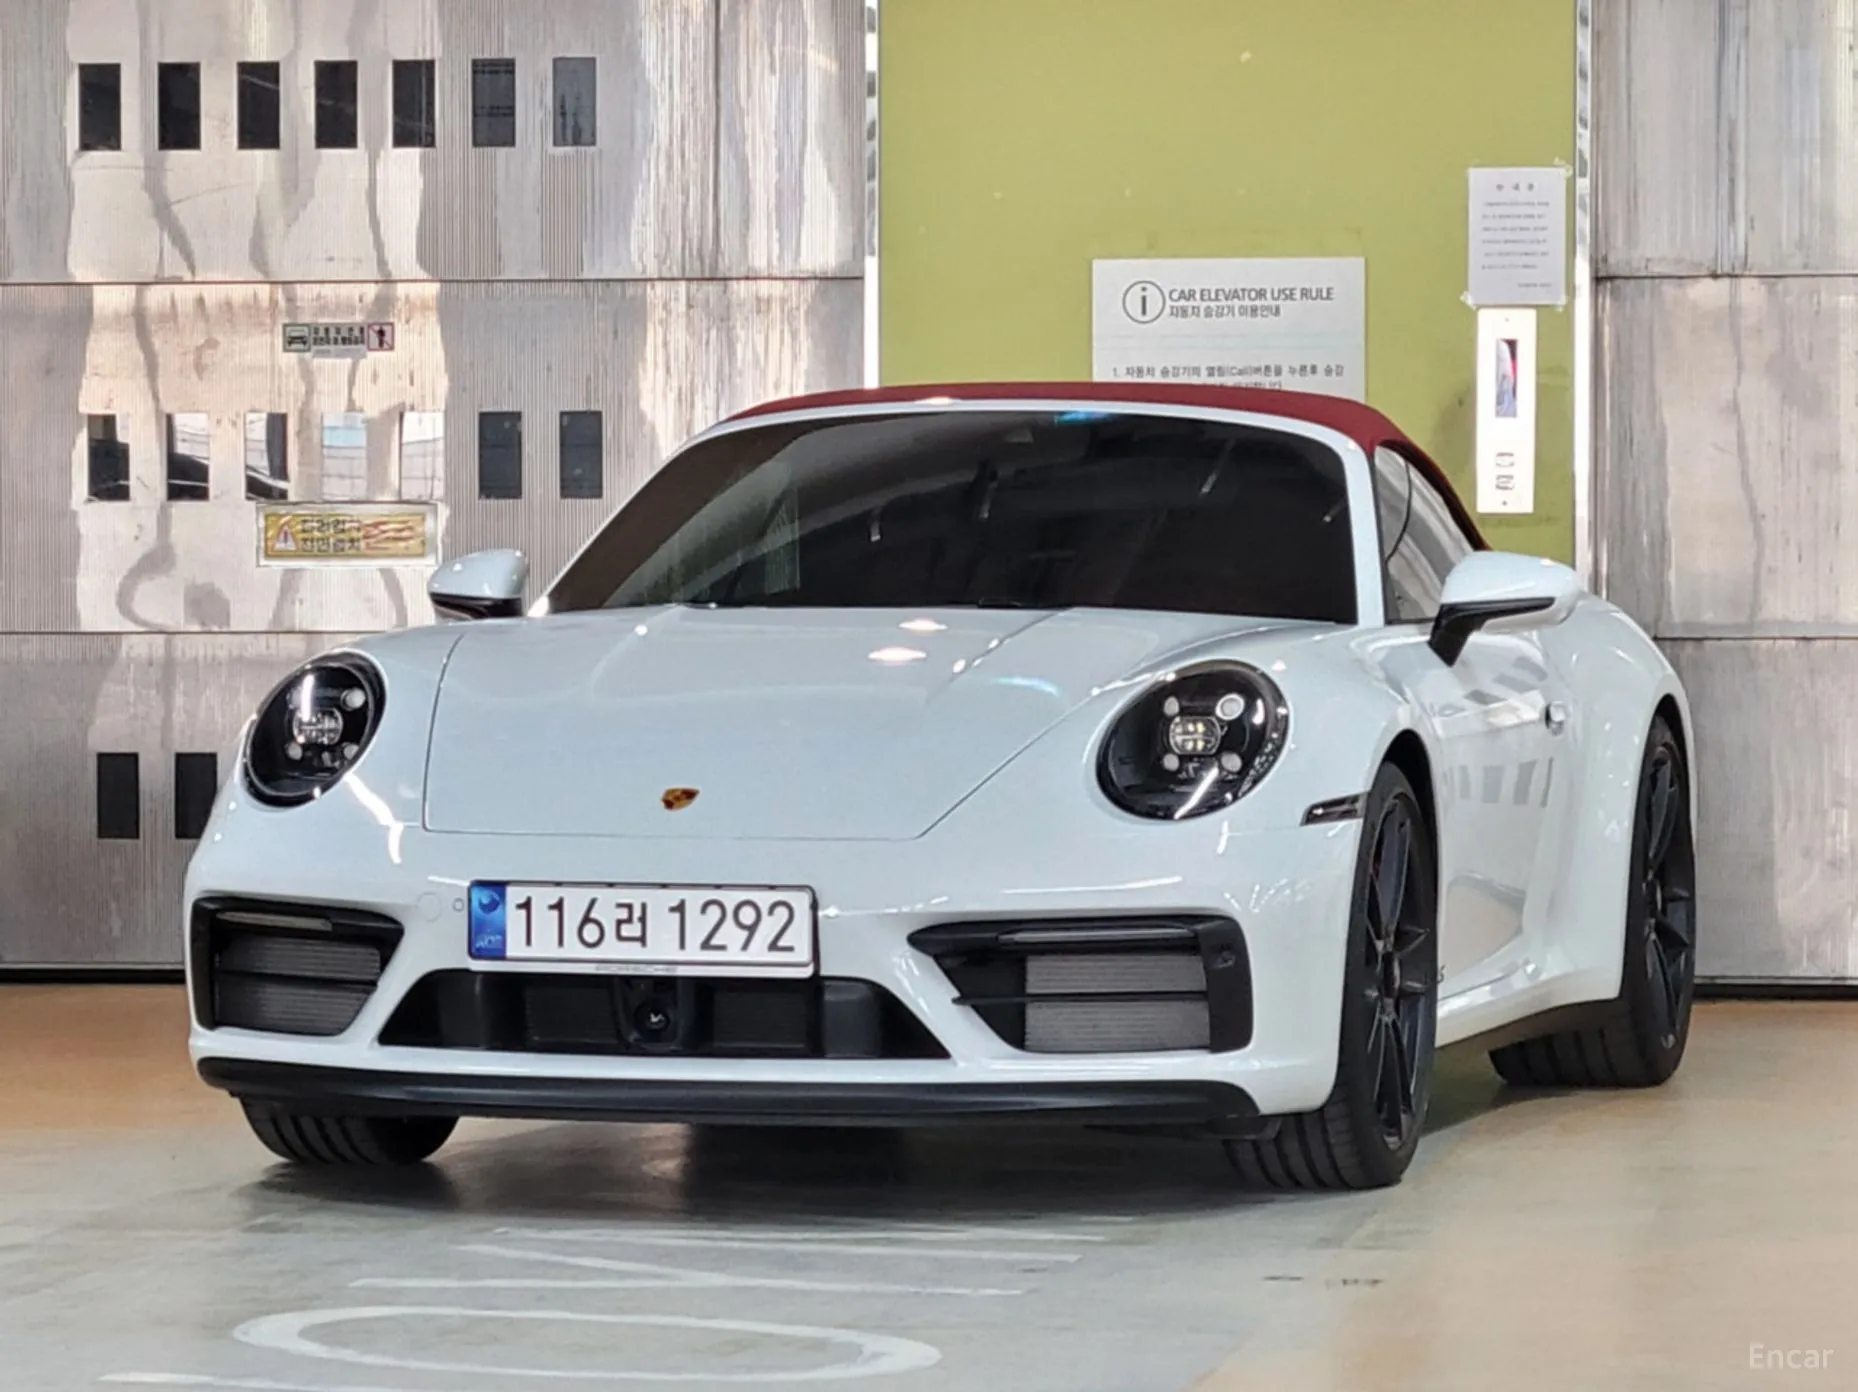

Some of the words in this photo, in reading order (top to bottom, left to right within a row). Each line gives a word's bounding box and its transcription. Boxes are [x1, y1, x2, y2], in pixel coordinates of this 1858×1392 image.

[1168, 288, 1197, 301] CAR
[1200, 287, 1267, 301] ELEVATOR
[1271, 287, 1298, 301] USE
[1300, 287, 1335, 300] RULE
[1169, 304, 1200, 318] 자동차
[1203, 304, 1235, 318] 승강기
[1238, 304, 1281, 317] 이용안내
[1125, 366, 1156, 378] 자동차
[515, 895, 648, 949] 116러
[668, 897, 796, 953] 1292
